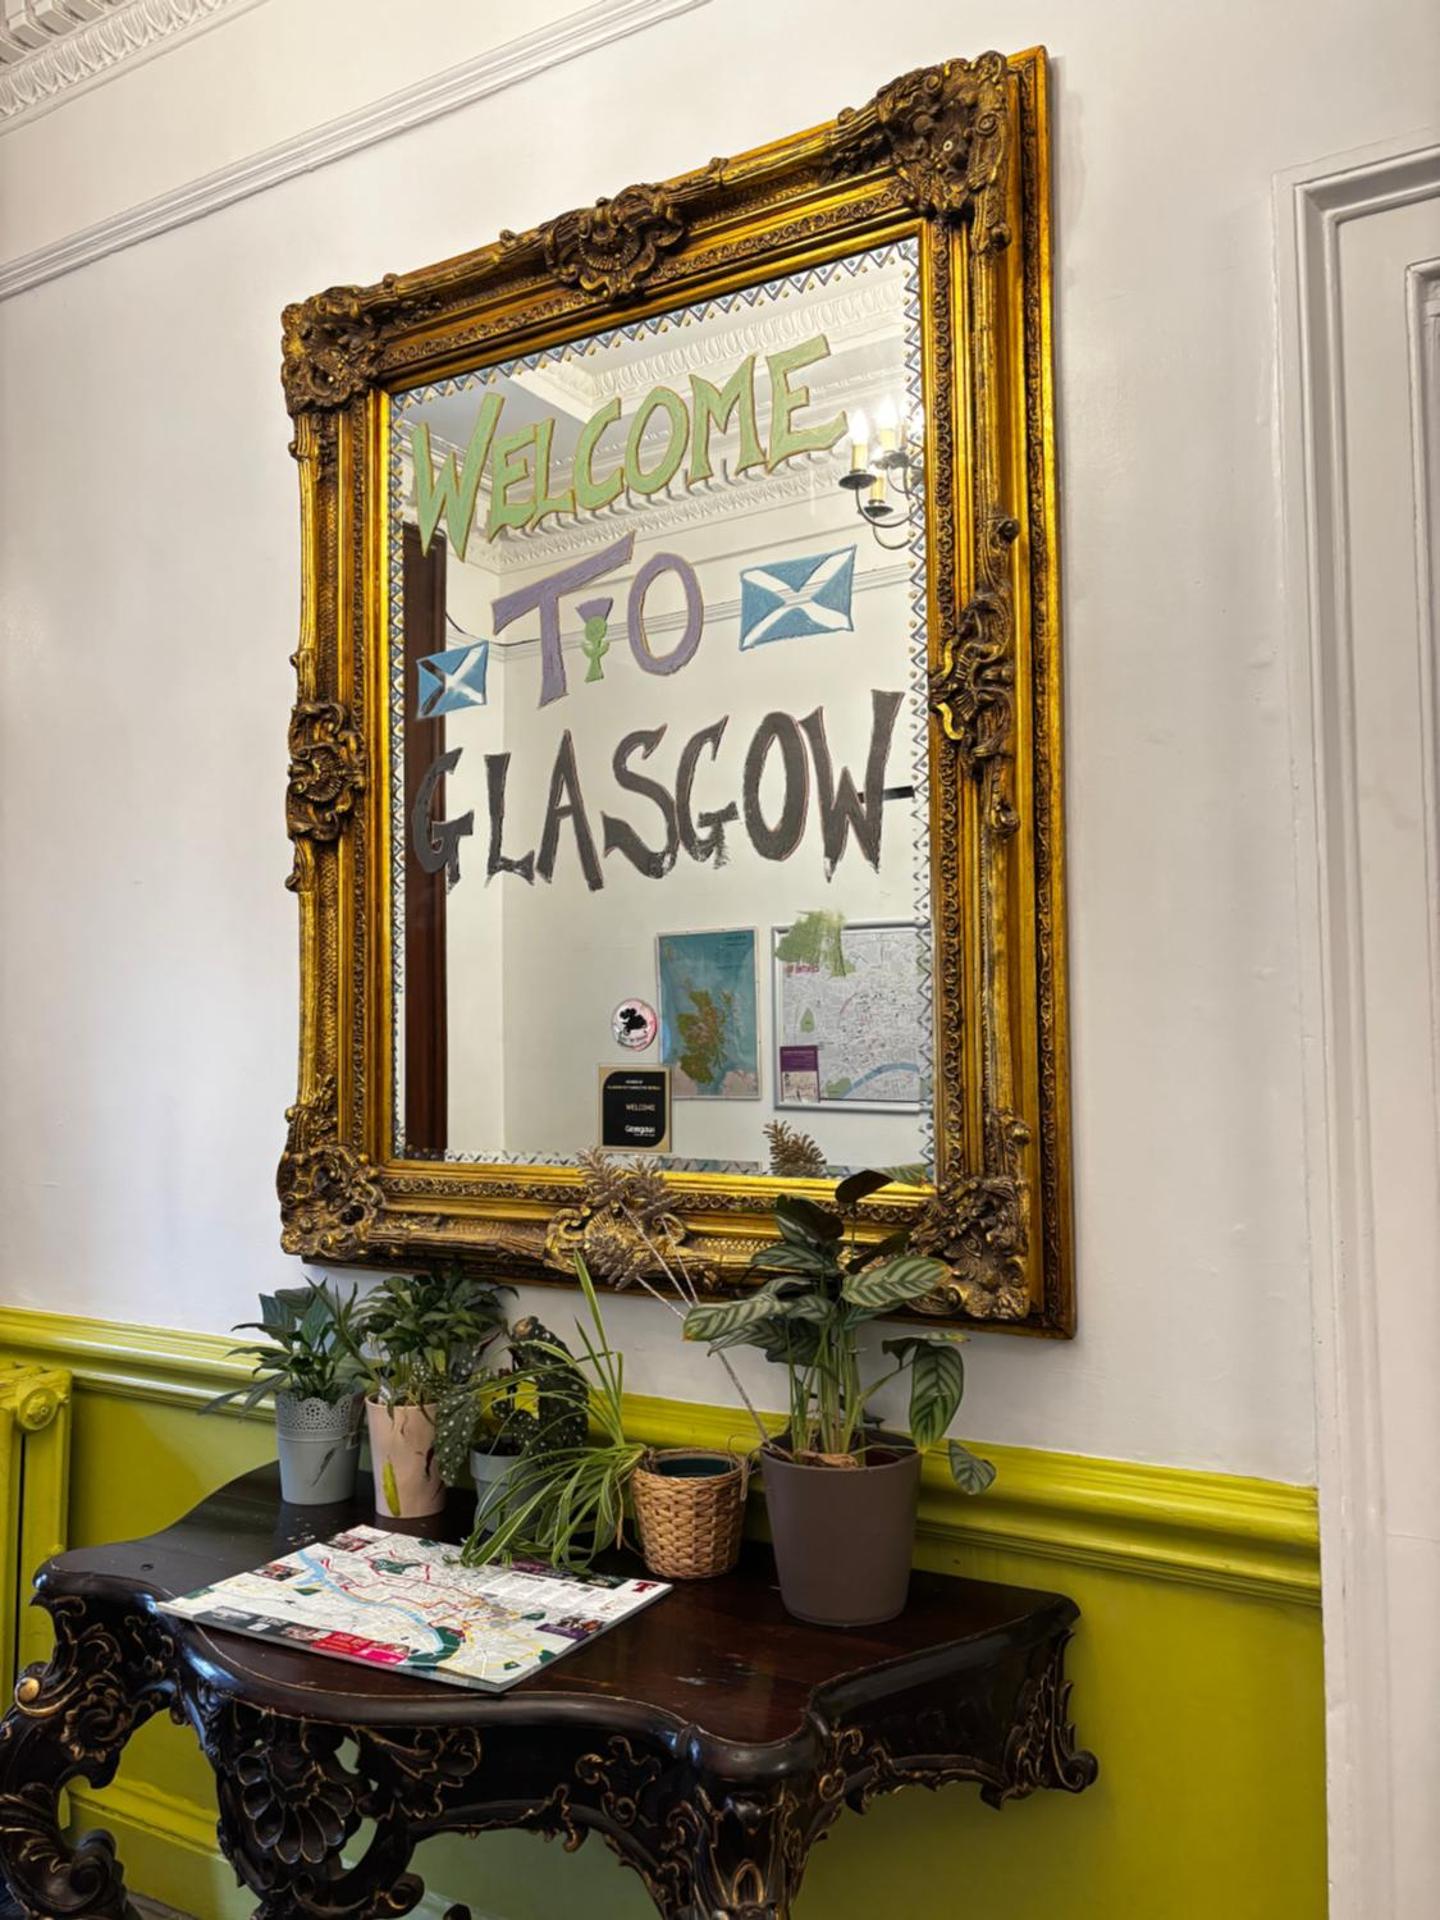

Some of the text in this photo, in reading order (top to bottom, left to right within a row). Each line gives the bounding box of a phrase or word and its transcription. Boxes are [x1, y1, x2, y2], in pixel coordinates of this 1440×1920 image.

[410, 333, 847, 562] WELCOME
[491, 531, 704, 708] TO
[411, 689, 905, 892] GLASGOW
